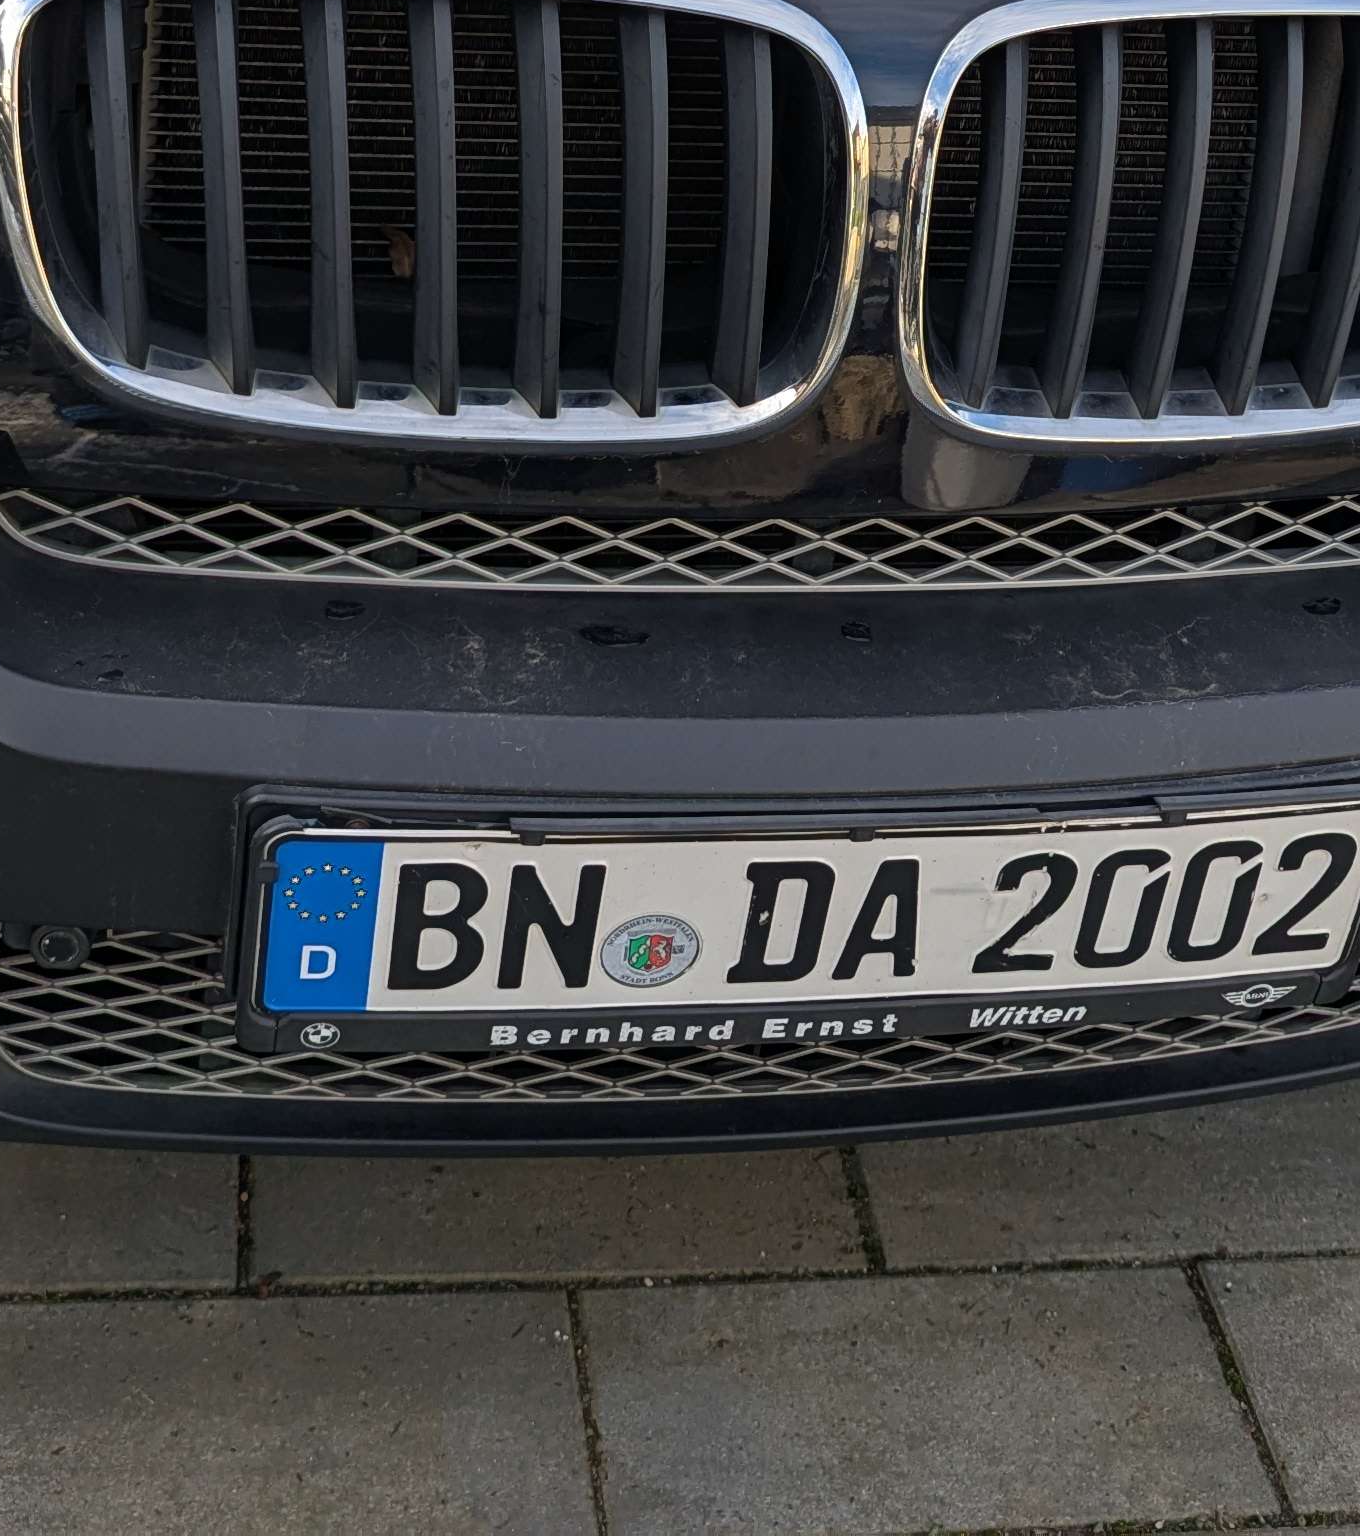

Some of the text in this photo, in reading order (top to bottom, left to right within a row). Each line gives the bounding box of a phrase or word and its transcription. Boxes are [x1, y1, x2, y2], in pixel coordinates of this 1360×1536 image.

[387, 832, 1358, 990] BN DA 2002
[299, 945, 336, 980] D
[490, 1004, 1088, 1045] Bernhard Ernst Witten
